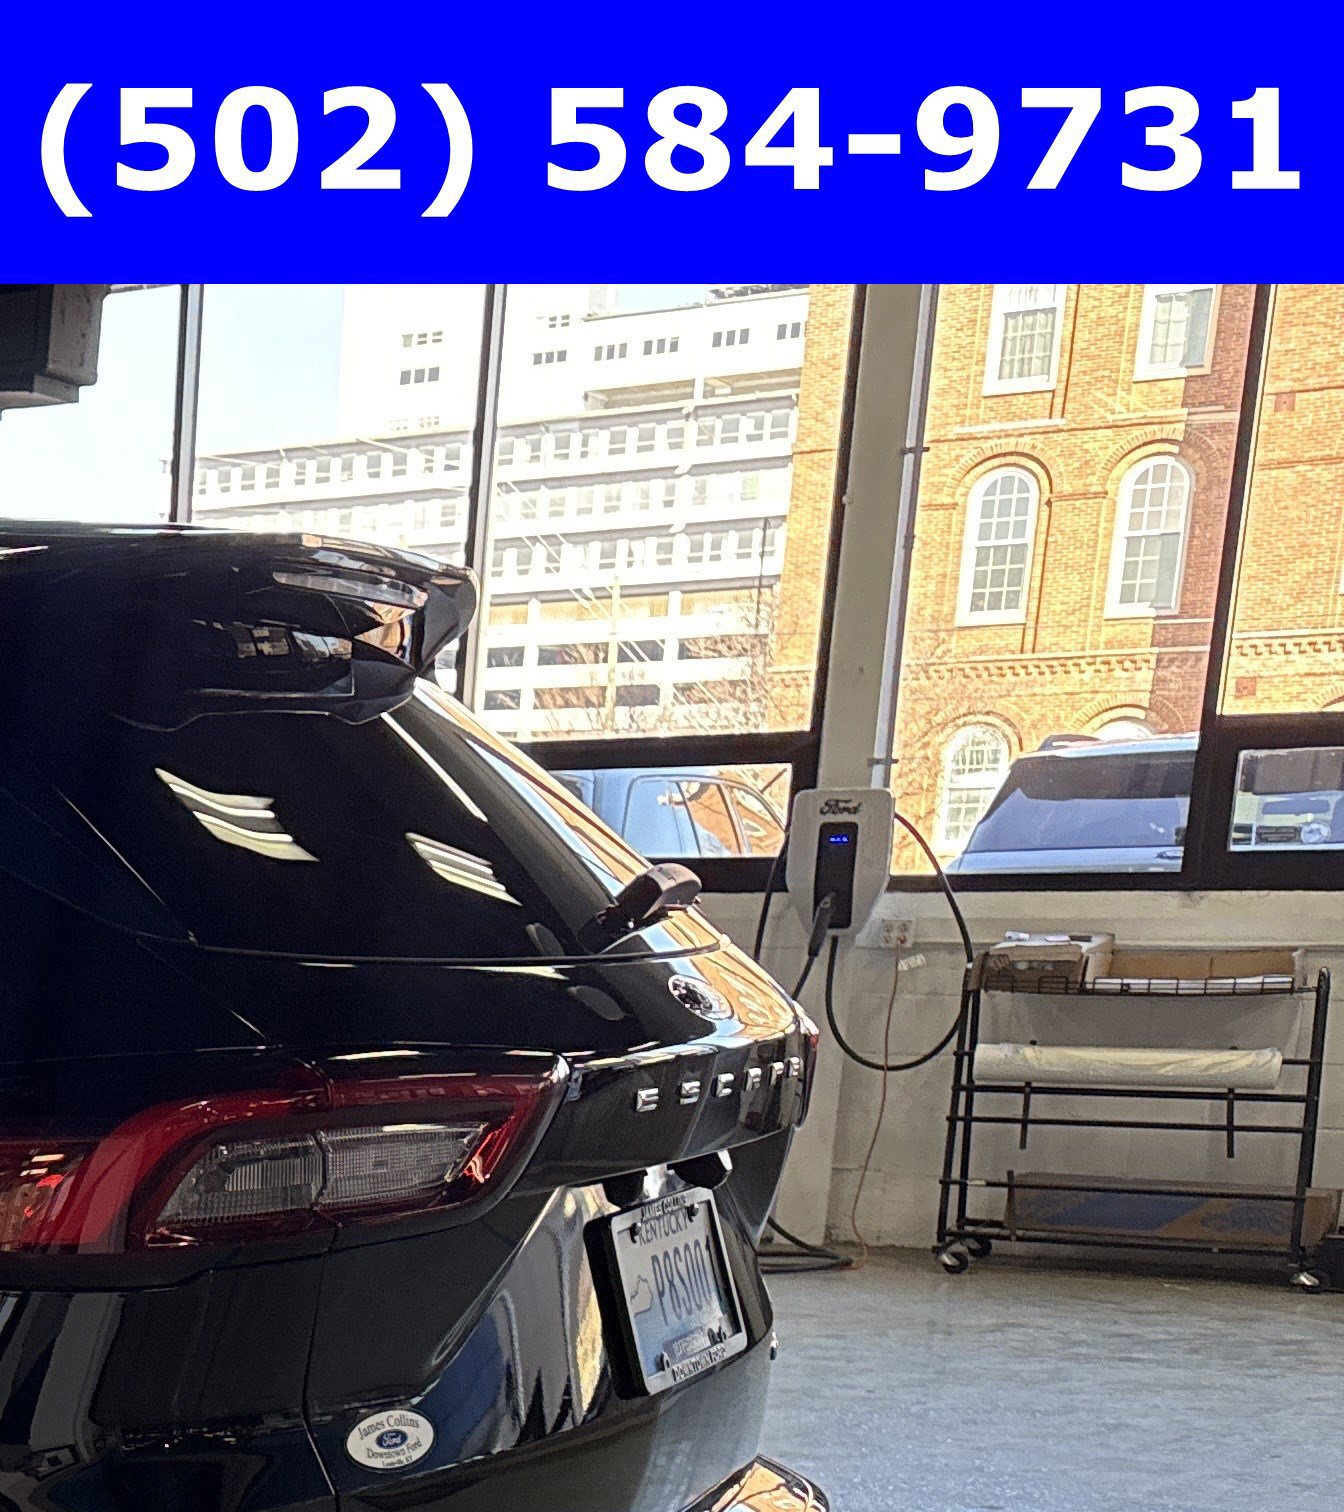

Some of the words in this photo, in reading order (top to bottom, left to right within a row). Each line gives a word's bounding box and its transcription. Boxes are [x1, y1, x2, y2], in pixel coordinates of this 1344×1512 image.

[820, 799, 862, 815] Ford
[638, 1207, 689, 1246] KENTUCKY
[651, 1235, 723, 1326] P8S001
[357, 1419, 386, 1440] James
[386, 1413, 420, 1429] Collins
[366, 1447, 406, 1460] Downtown
[406, 1436, 423, 1454] Ford
